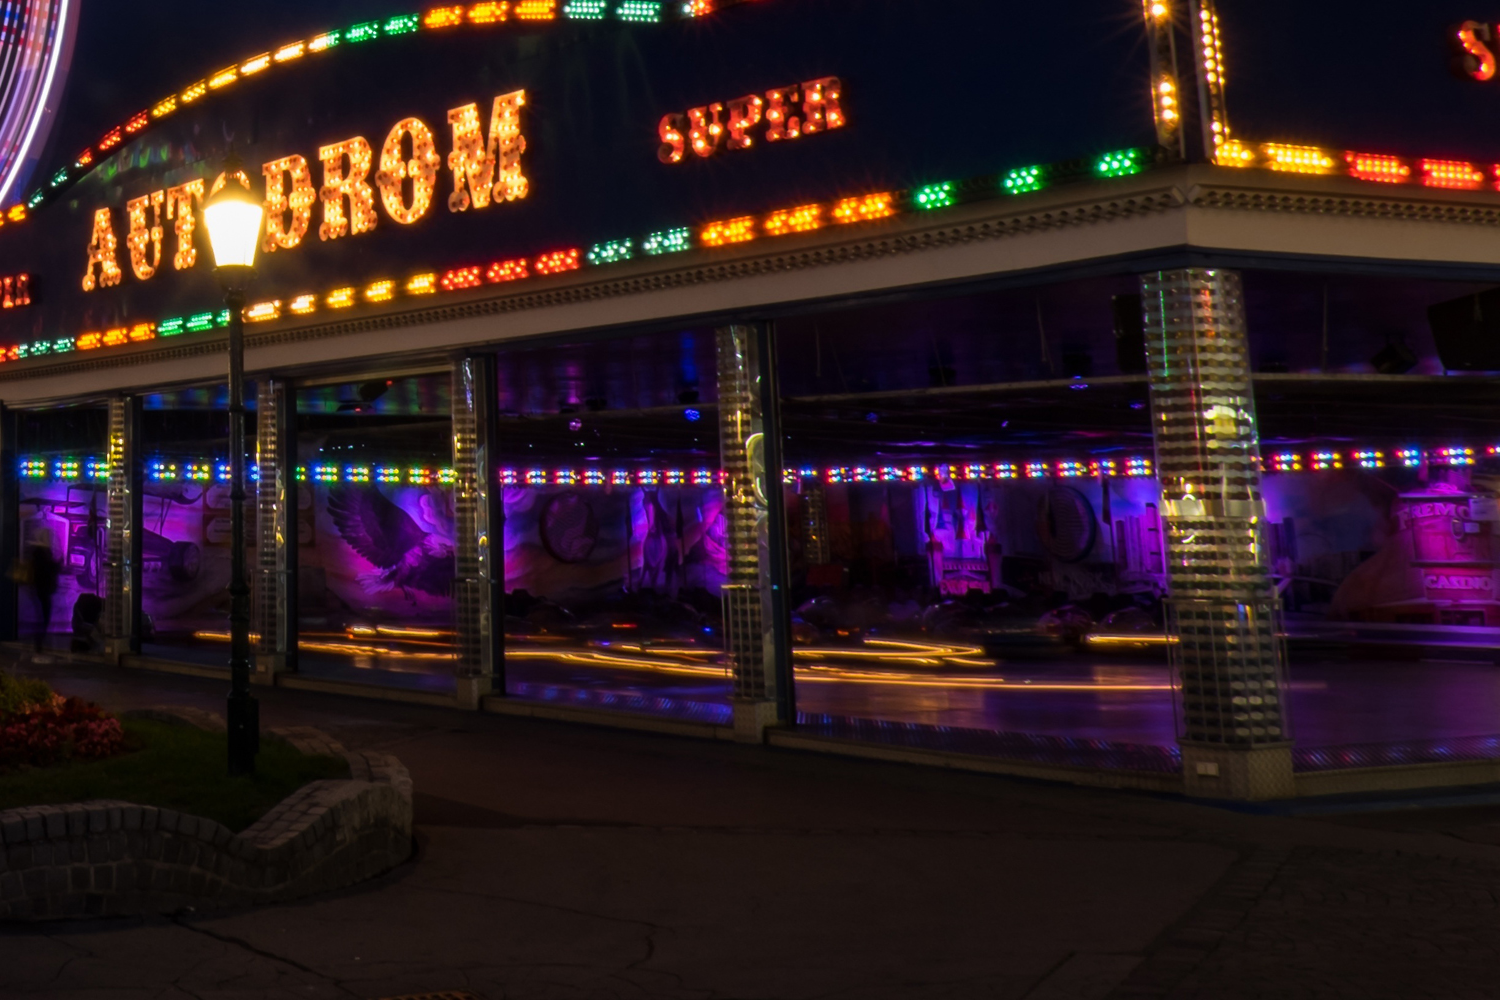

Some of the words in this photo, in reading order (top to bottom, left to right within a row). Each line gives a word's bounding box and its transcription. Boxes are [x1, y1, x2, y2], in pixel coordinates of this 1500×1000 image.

[1456, 19, 1500, 82] S
[657, 76, 847, 164] SUPER
[81, 89, 530, 292] AUTDROM
[1425, 574, 1493, 592] CASINO
